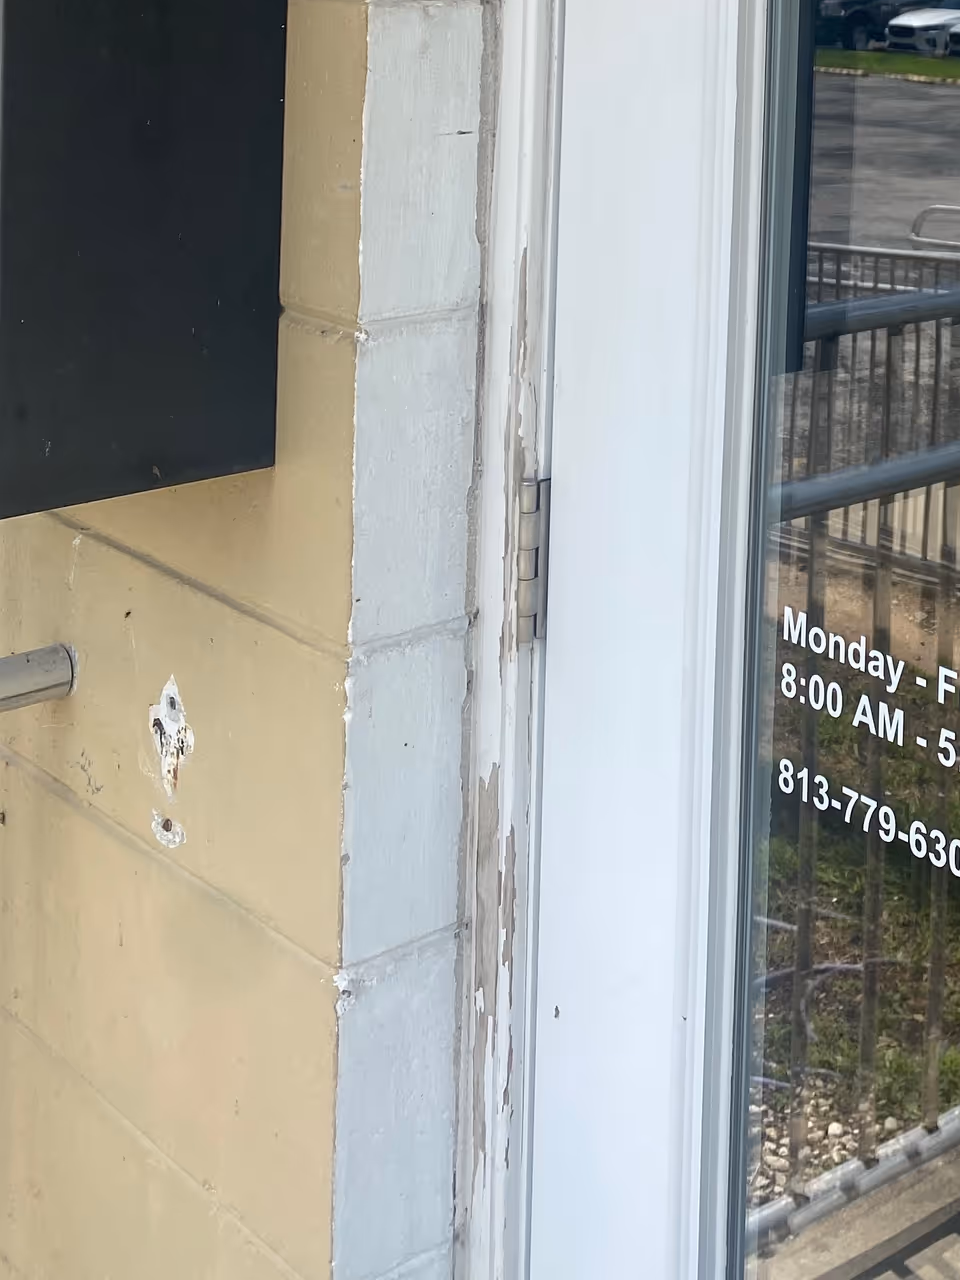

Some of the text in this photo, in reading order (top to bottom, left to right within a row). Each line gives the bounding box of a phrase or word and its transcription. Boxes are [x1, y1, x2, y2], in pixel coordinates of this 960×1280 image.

[783, 606, 905, 694] Monday
[780, 662, 843, 719] 8:00
[852, 694, 905, 747] AM
